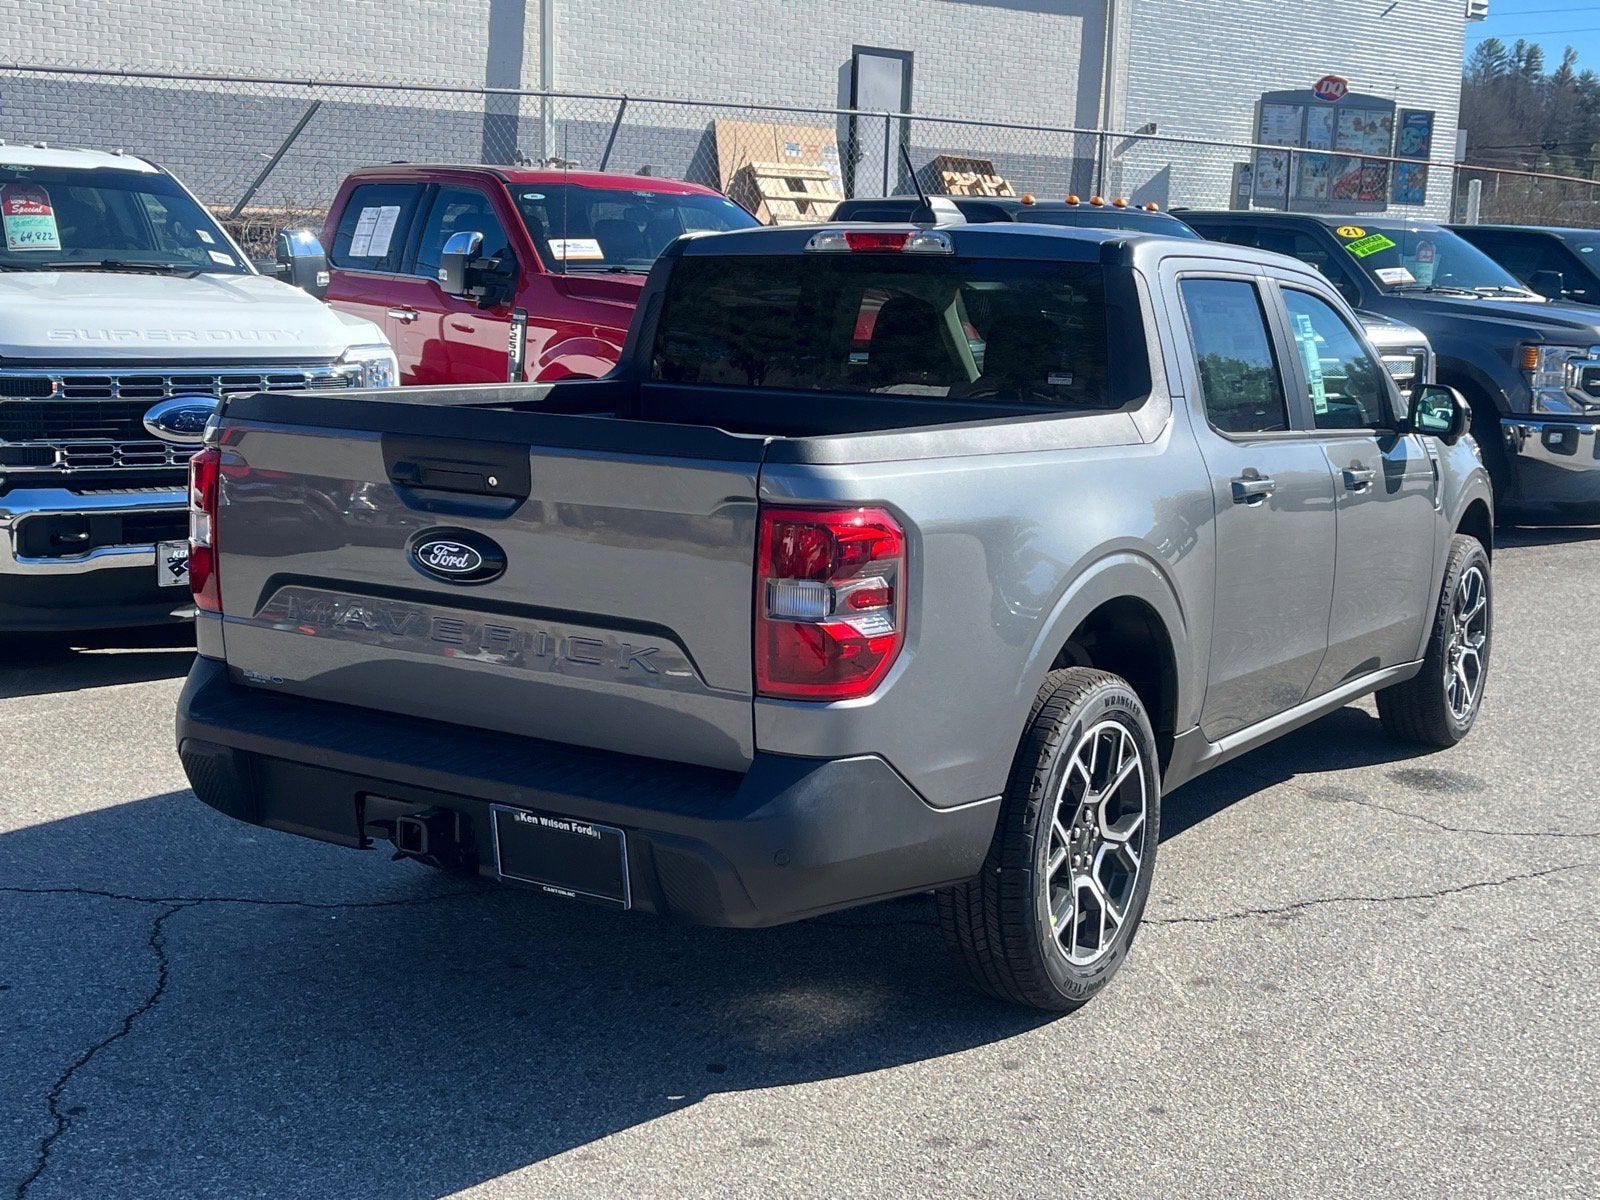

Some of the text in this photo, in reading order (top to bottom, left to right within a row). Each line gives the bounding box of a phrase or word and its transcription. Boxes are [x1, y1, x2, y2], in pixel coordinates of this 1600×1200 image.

[1320, 80, 1345, 97] DQ
[11, 204, 43, 215] Special
[1343, 228, 1359, 236] 21
[46, 328, 304, 342] SUPER DUTY
[429, 544, 469, 568] Ford
[286, 595, 660, 674] MAVERICK
[1104, 695, 1141, 717] WRANGLER
[519, 811, 592, 836] Ken Wilson Ford
